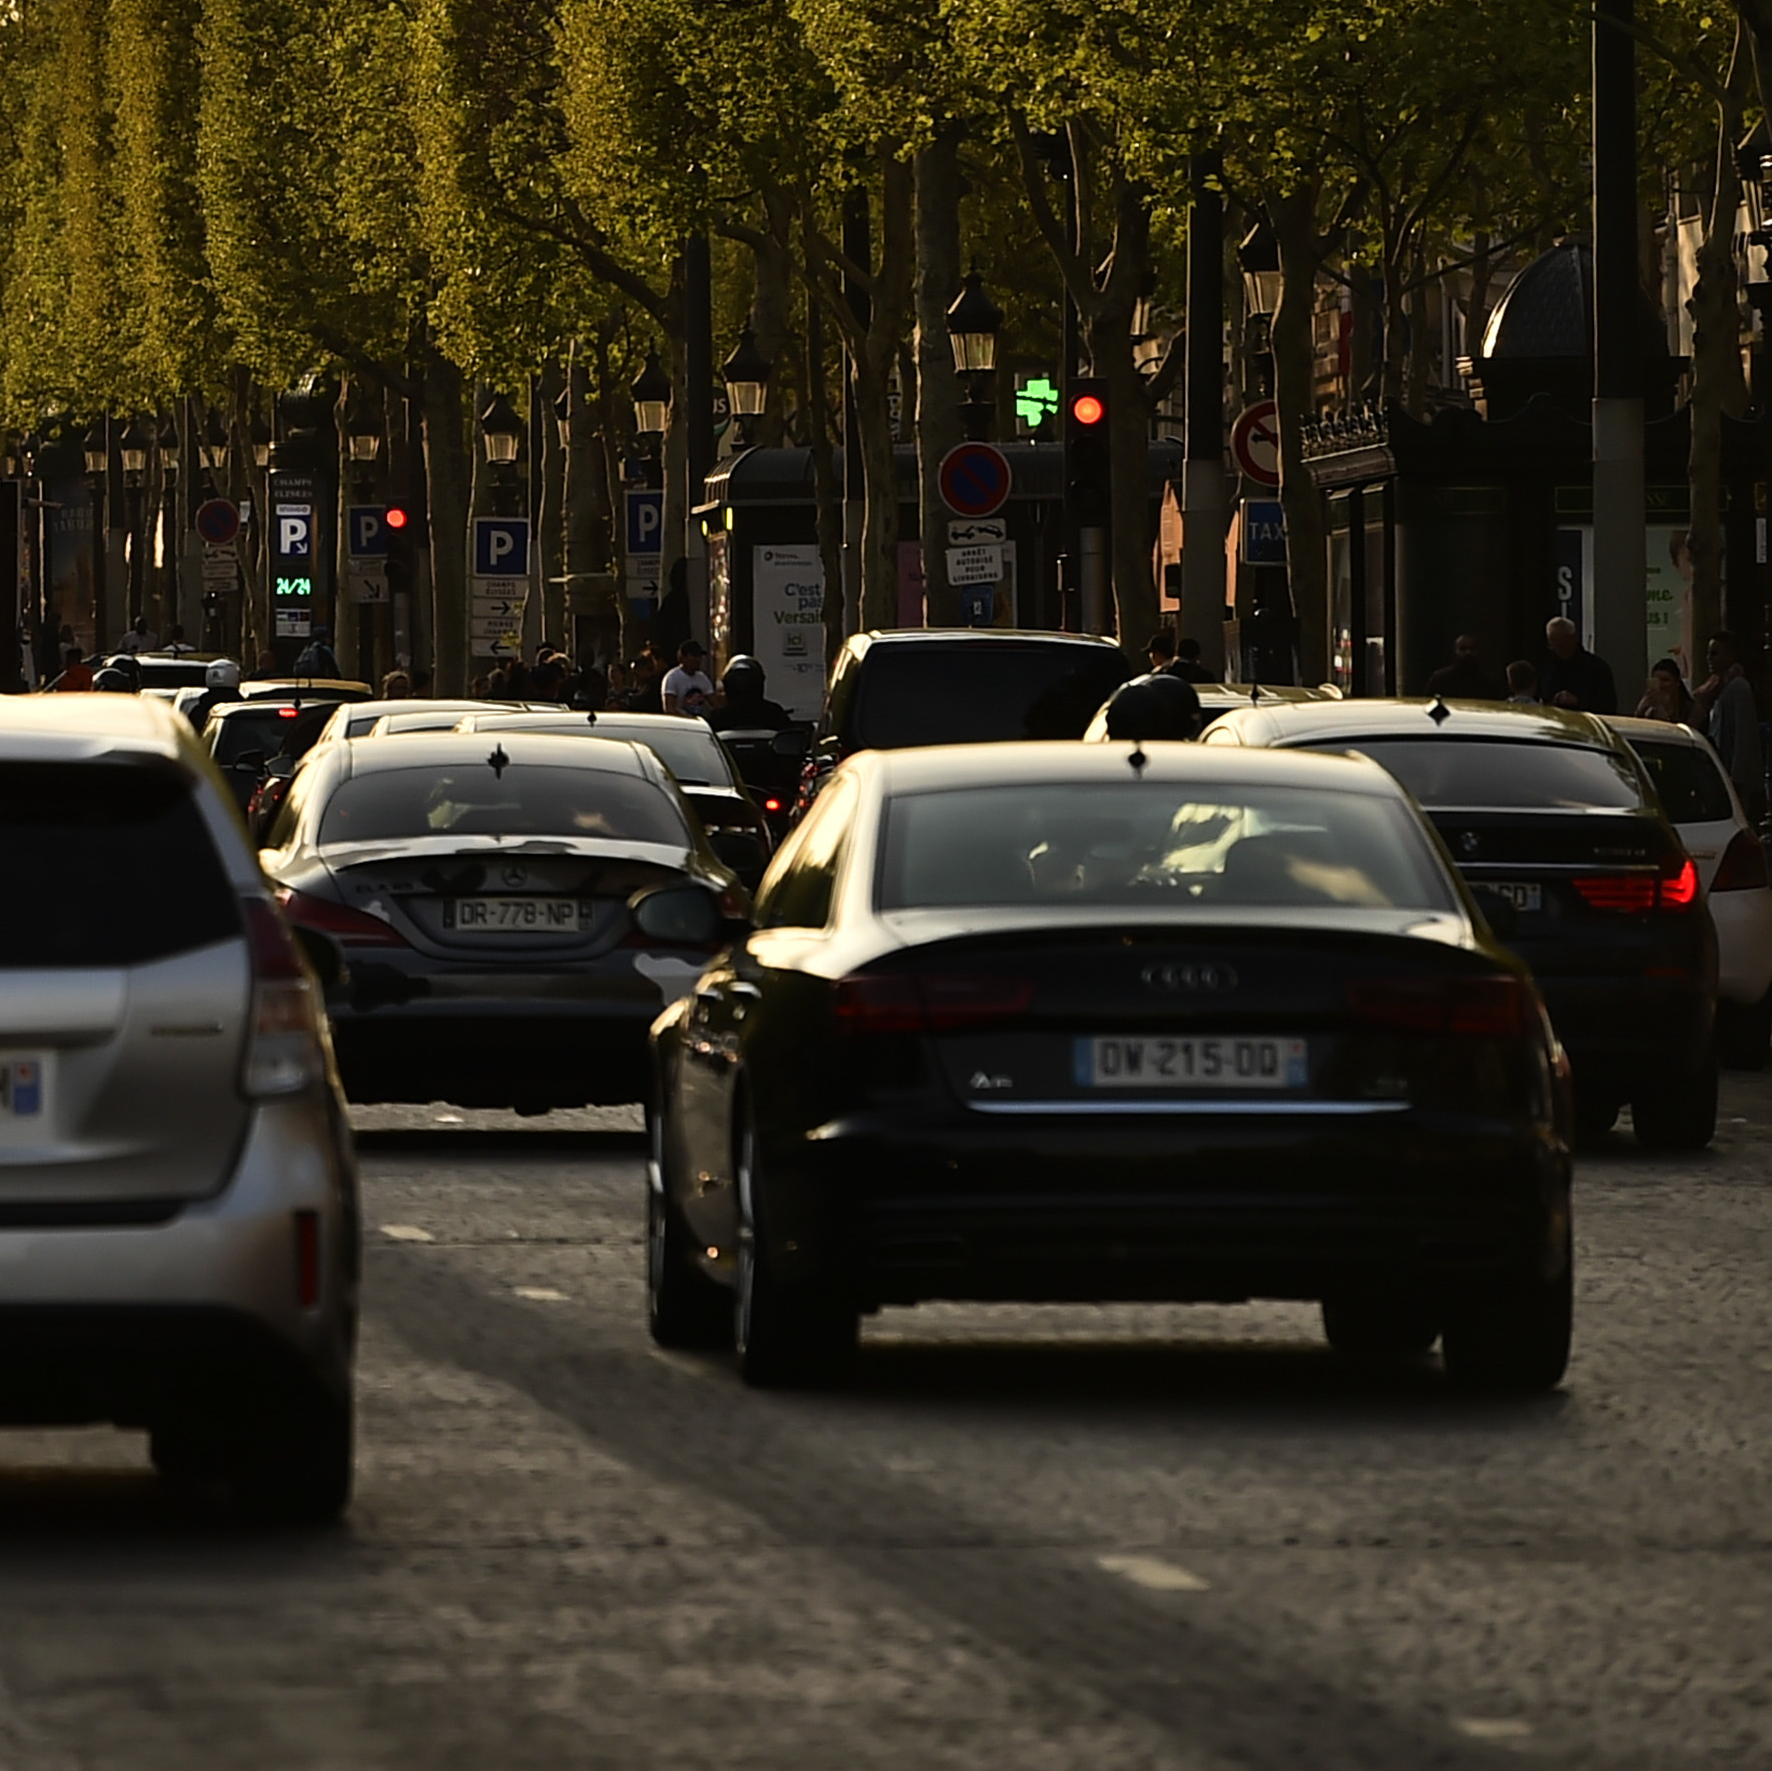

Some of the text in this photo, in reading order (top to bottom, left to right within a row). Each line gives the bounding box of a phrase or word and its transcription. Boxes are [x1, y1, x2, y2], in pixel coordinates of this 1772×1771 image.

[279, 518, 308, 554] P
[360, 515, 379, 547] P
[638, 503, 660, 543] P
[1249, 522, 1286, 540] TAX
[489, 530, 514, 565] P
[276, 577, 311, 595] 24/24
[784, 582, 821, 596] C'est
[773, 610, 824, 624] Versai
[460, 899, 574, 926] DR-778-NP
